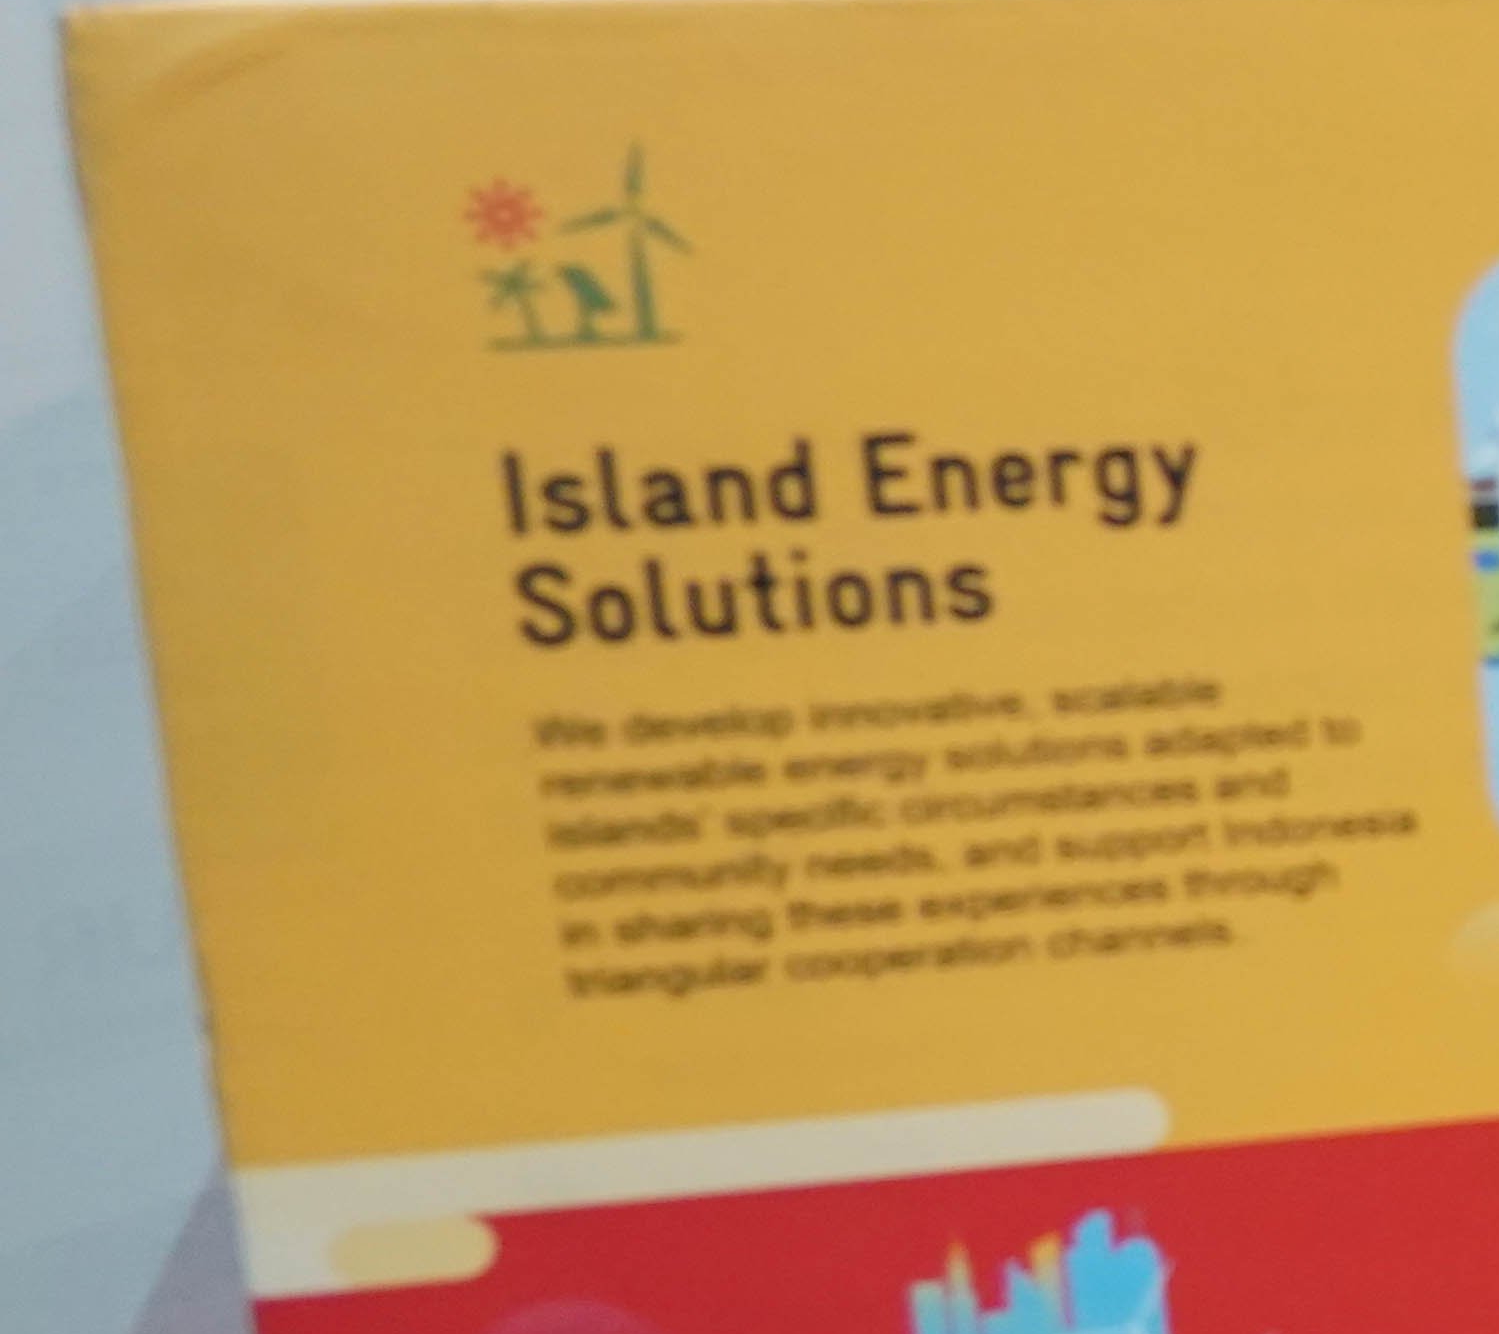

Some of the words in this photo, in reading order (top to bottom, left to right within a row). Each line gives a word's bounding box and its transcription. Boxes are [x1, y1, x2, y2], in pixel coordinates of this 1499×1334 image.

[507, 439, 818, 536] Island
[860, 431, 1196, 529] Energy
[515, 550, 994, 649] Solutions
